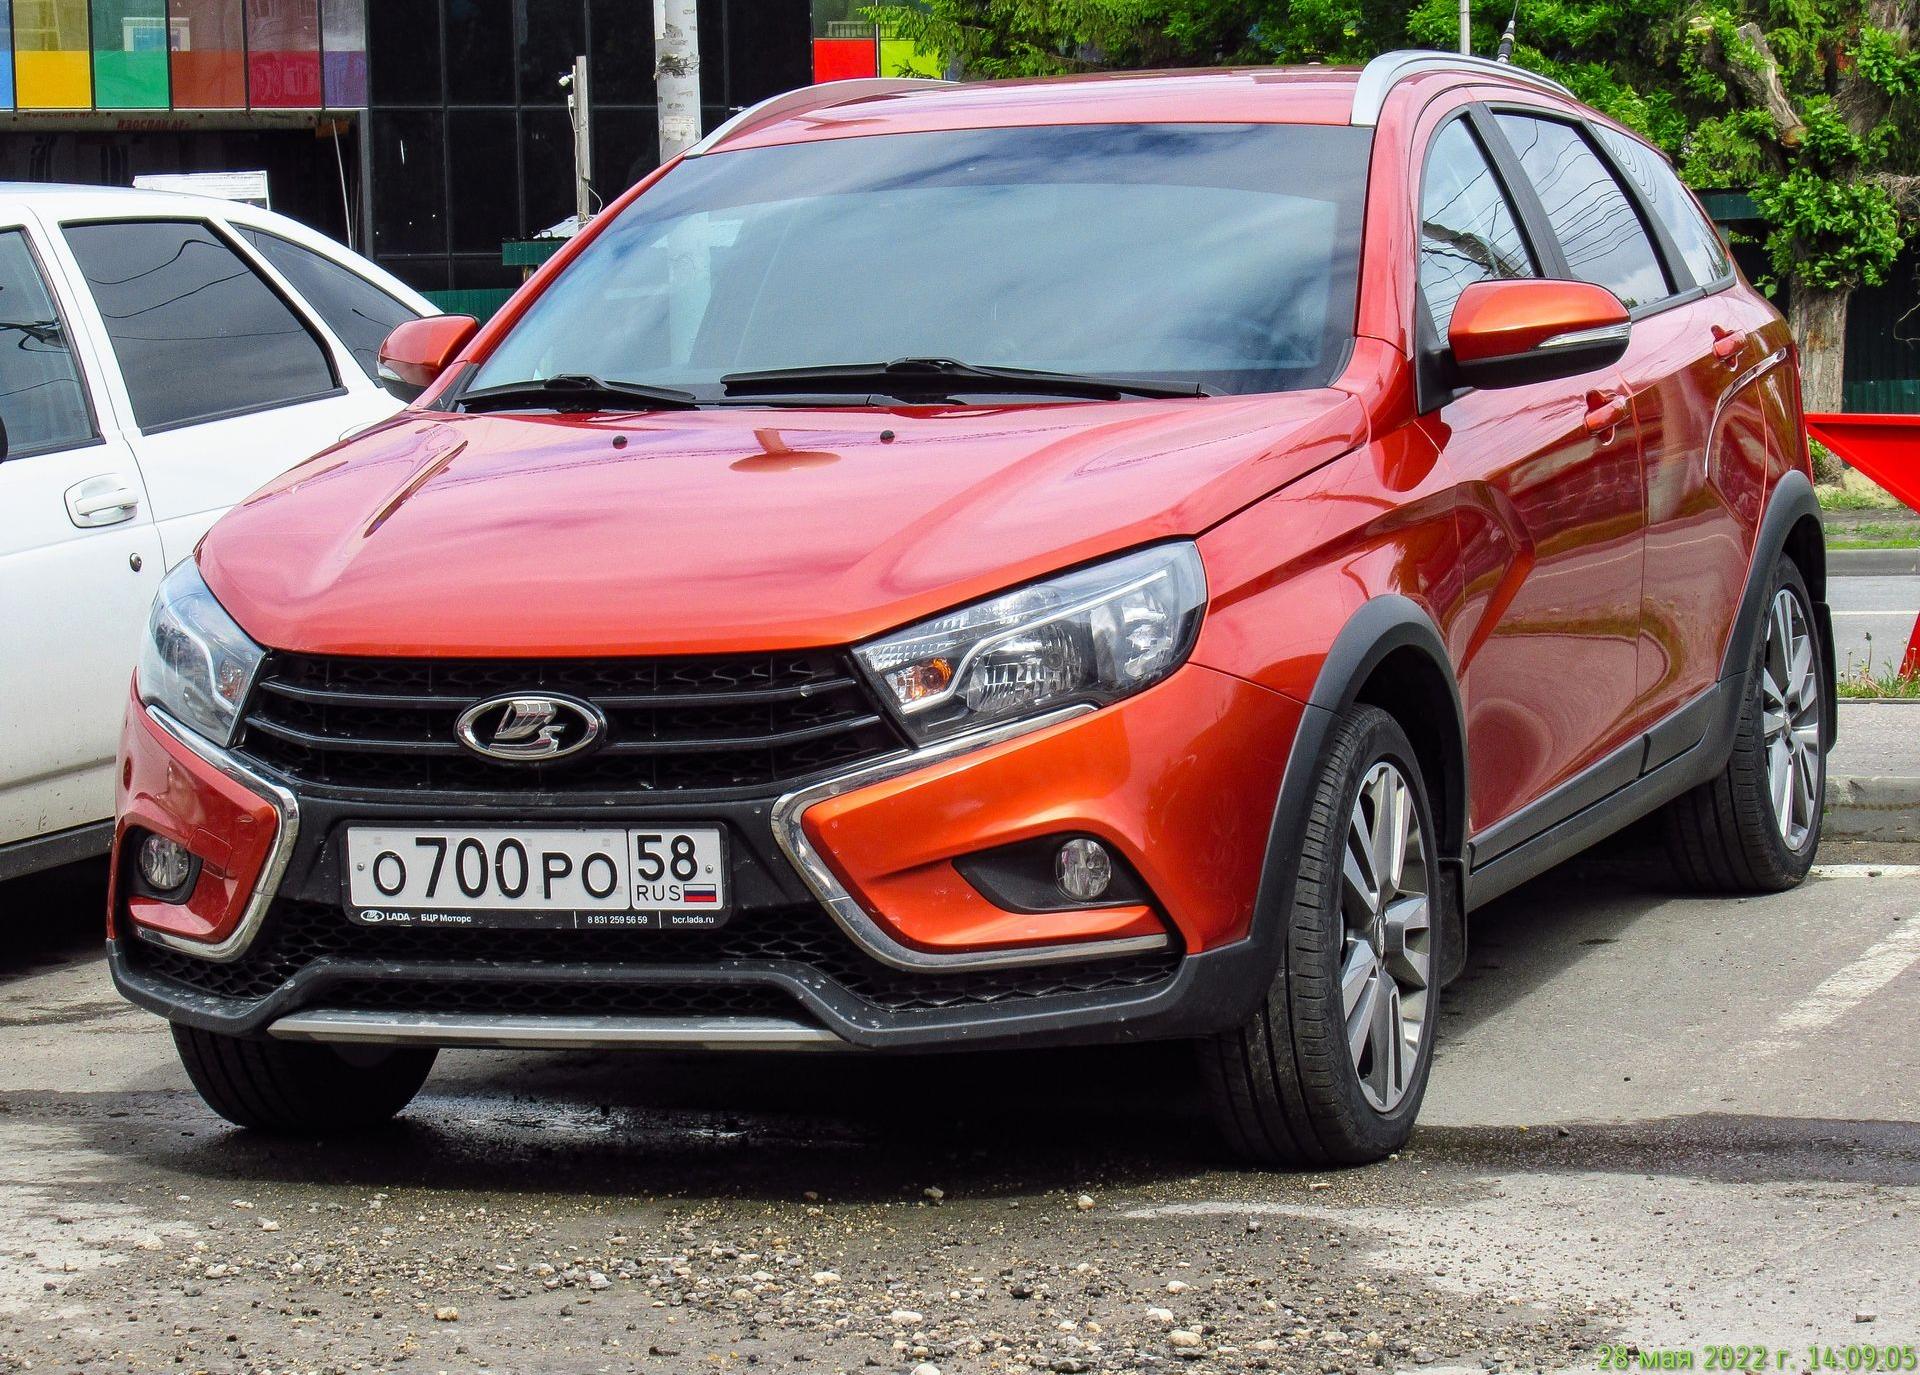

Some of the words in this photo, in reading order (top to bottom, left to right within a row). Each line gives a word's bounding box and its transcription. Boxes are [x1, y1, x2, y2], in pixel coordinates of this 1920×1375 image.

[636, 834, 698, 882] 58
[636, 885, 681, 902] RUS
[386, 912, 411, 922] LADA
[420, 913, 439, 923] БЦР
[440, 914, 472, 924] Моторс
[587, 915, 593, 924] 8
[594, 915, 608, 924] 831
[609, 915, 625, 924] 259
[626, 915, 637, 924] 56
[637, 915, 648, 924] 59
[672, 915, 714, 924] bcr.lada.ru
